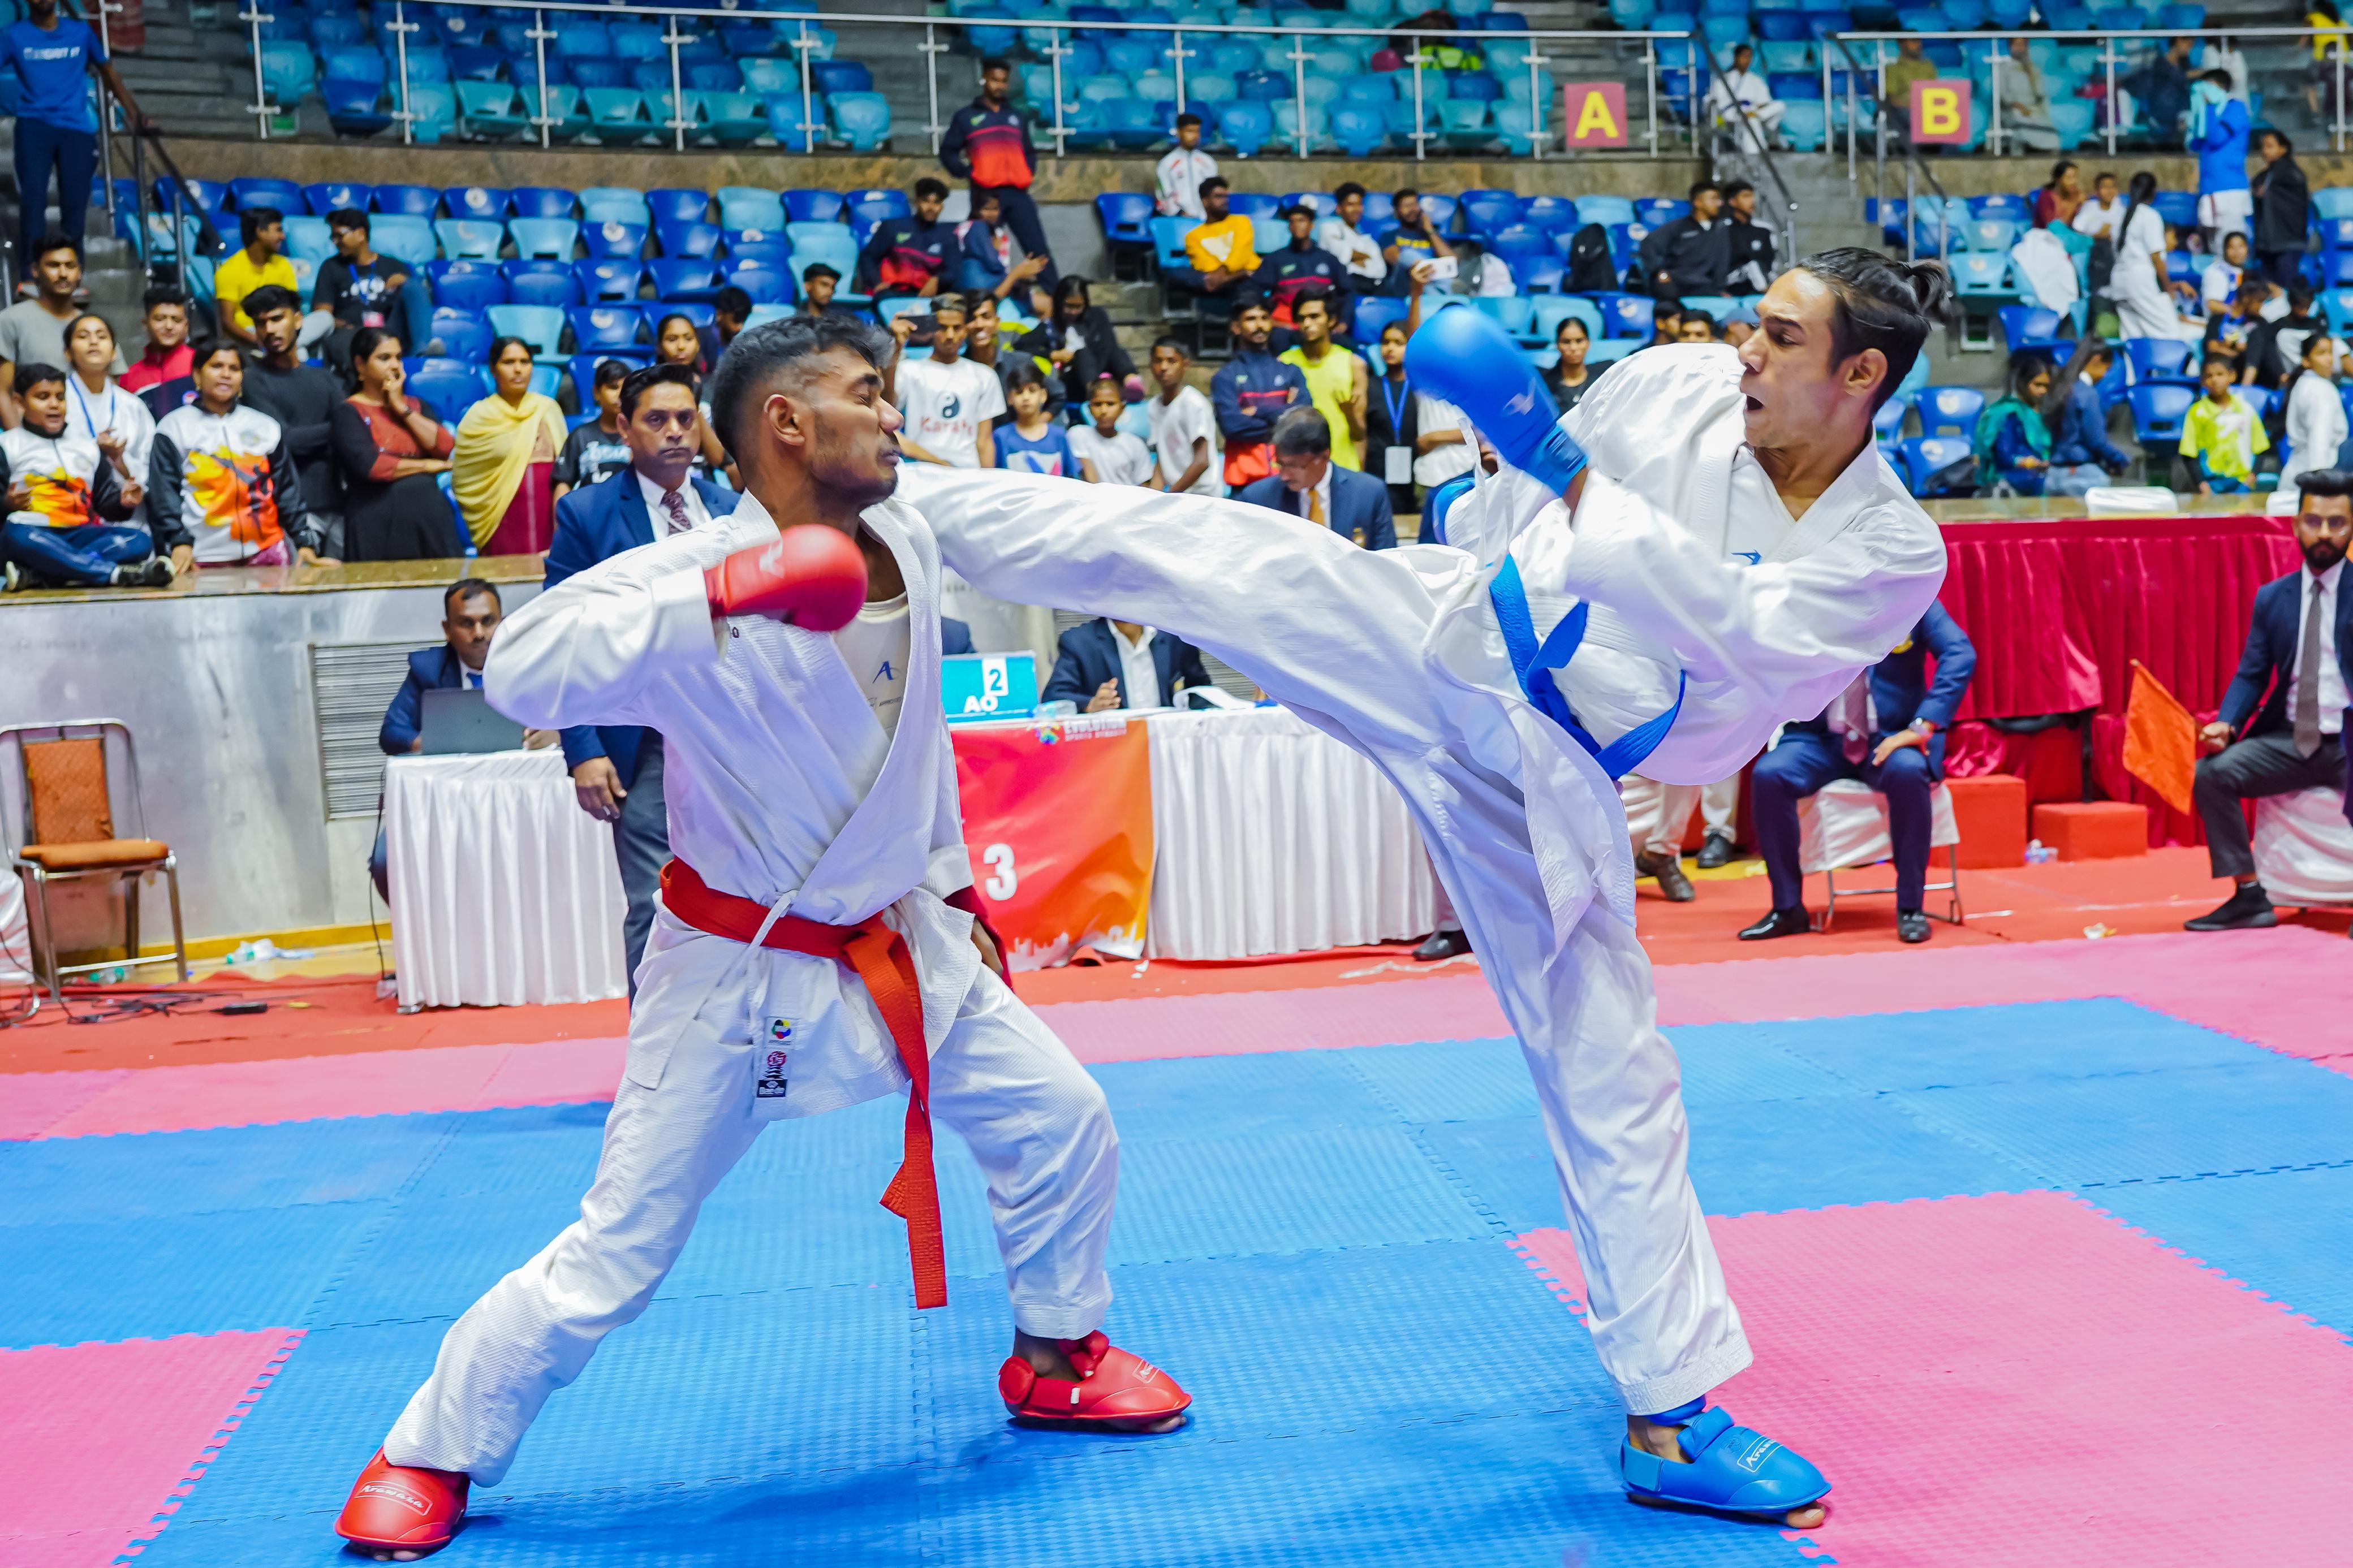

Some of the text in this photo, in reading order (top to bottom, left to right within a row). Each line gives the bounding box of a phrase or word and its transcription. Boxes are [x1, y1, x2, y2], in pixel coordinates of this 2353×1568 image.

[1574, 90, 1620, 139] A
[1921, 88, 1961, 135] B
[989, 668, 1003, 691] 2
[963, 694, 999, 714] AO
[982, 843, 1018, 901] 3
